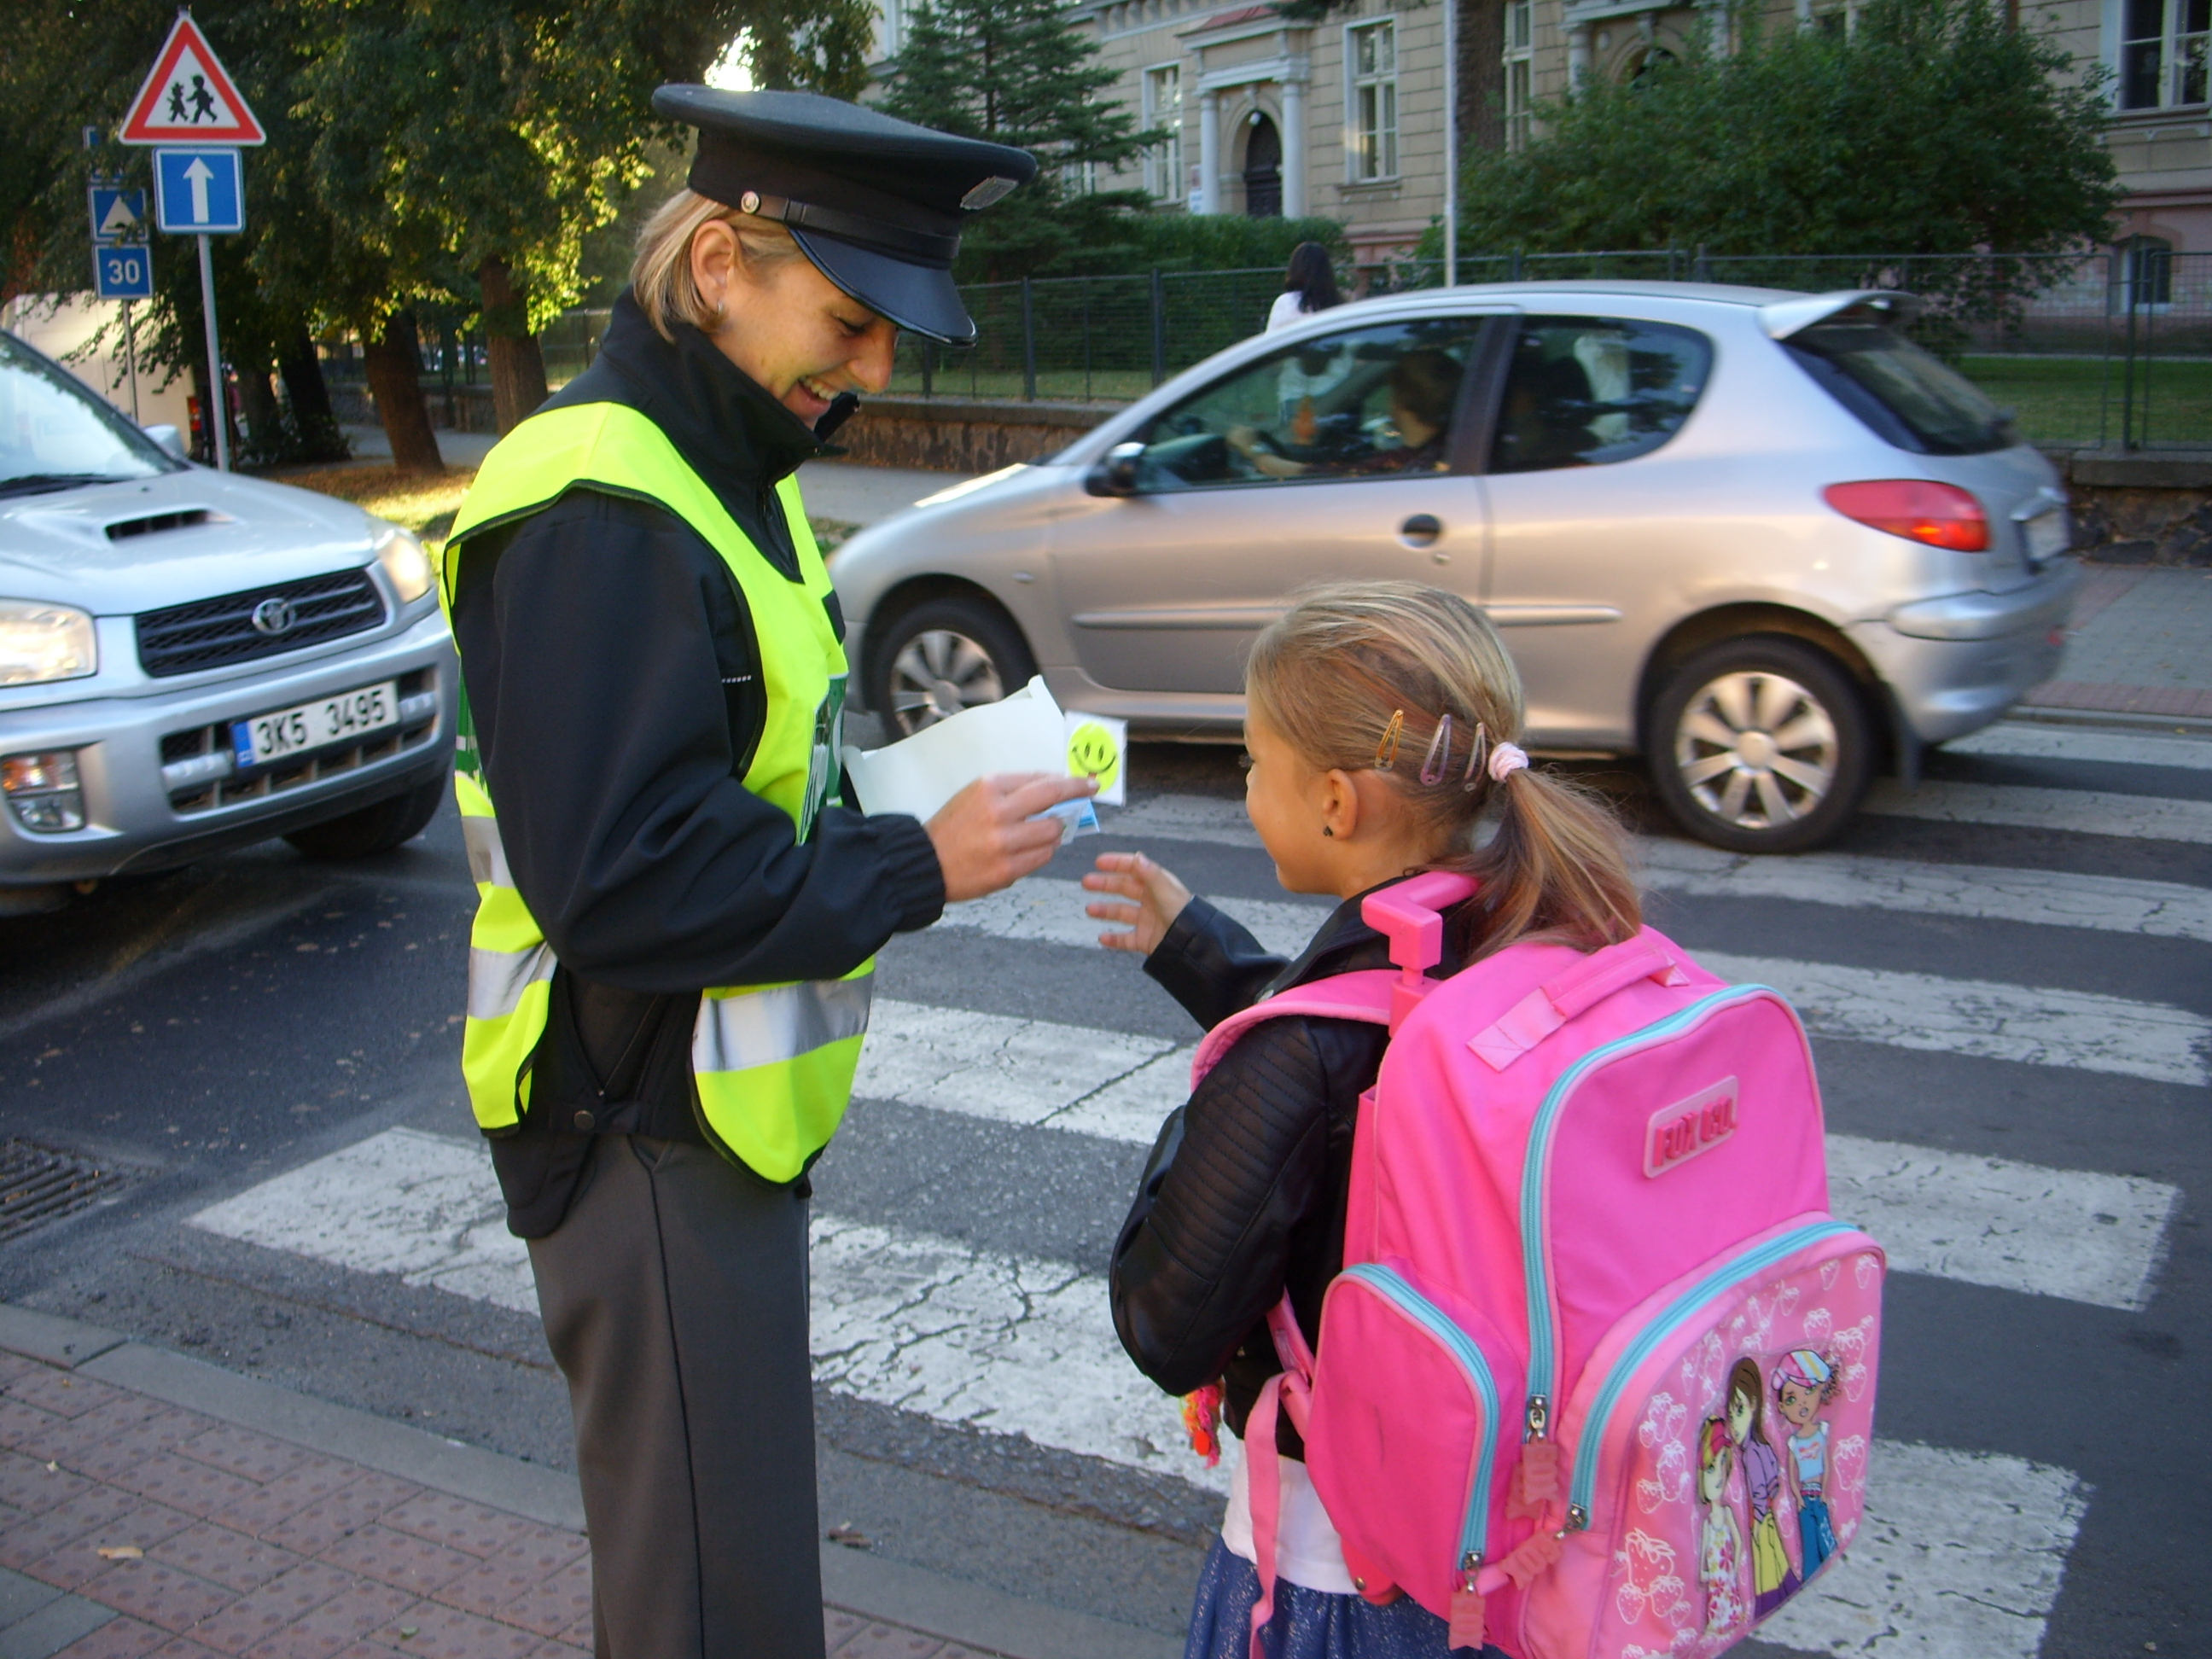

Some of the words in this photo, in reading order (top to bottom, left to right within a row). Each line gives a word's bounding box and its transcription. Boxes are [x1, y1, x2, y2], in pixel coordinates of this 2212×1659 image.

[108, 259, 140, 285] 30
[256, 711, 308, 754] 3K5
[325, 689, 387, 736] 3495
